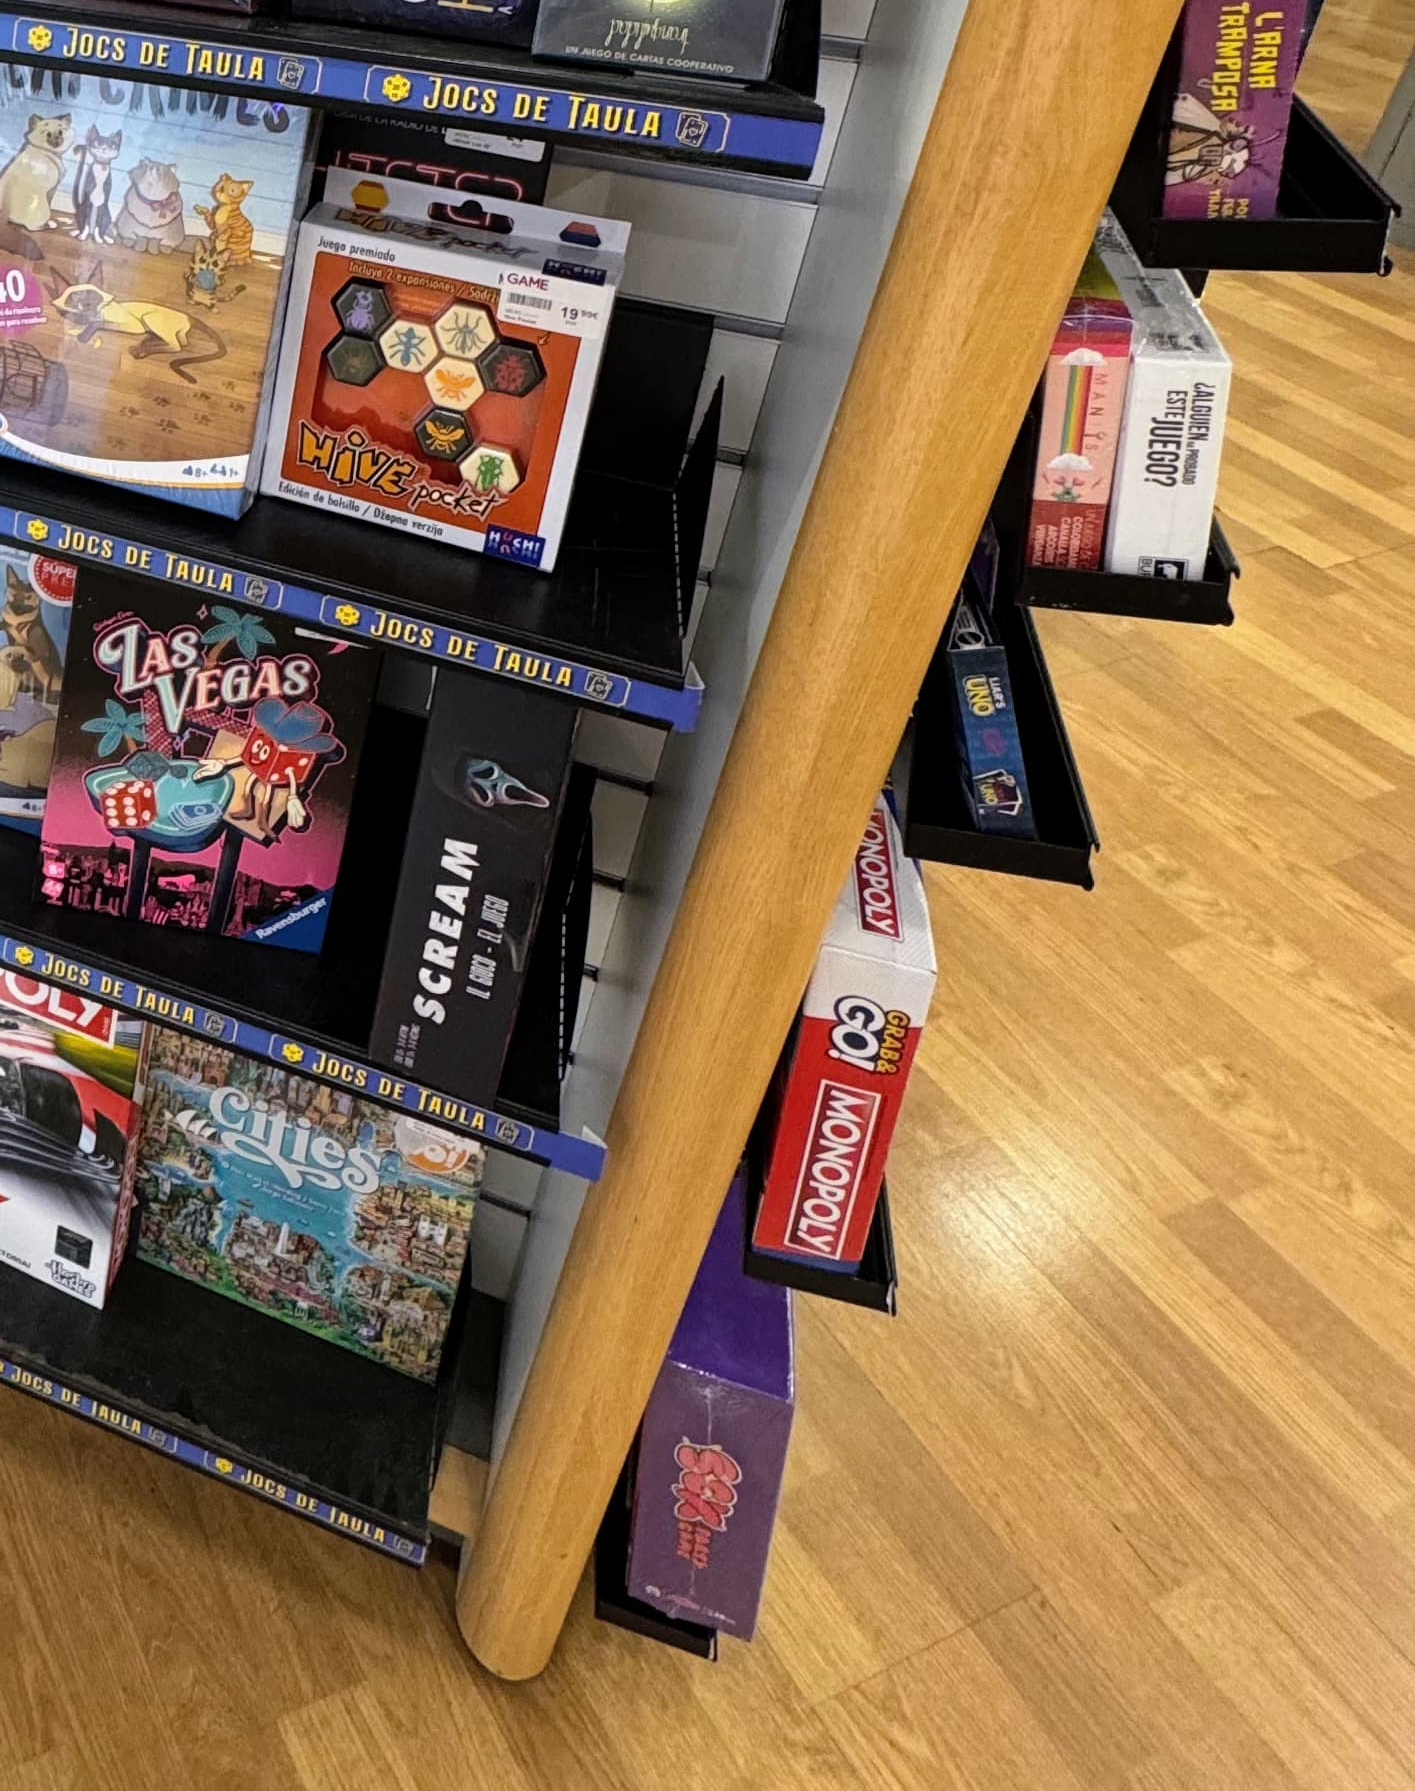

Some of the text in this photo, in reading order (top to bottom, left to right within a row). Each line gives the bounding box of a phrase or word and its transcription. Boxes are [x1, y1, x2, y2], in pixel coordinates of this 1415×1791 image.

[581, 48, 612, 58] JUEGO
[614, 51, 626, 60] DE
[630, 53, 664, 65] CARTAS
[667, 57, 734, 74] COOPERATIVO
[1211, 0, 1251, 113] TRAMPOSA
[317, 237, 396, 263] Juego premiado
[349, 261, 455, 294] Incluye 2 expansiones
[1144, 390, 1188, 488] ESTE JUEGO?
[1188, 382, 1216, 441] ¿ALGUIEN
[278, 482, 309, 502] Edición
[312, 491, 324, 504] de
[328, 492, 361, 514] bolsillo
[411, 480, 504, 517] pocket
[94, 621, 205, 696] LAS
[155, 660, 312, 735] VEGAS
[964, 674, 994, 719] UNO
[254, 895, 328, 941] Ravensburger
[412, 837, 480, 1026] SCREAM
[827, 996, 887, 1074] GO!
[312, 1052, 486, 1130] JOCS DE TAULA
[796, 1089, 867, 1254] MONOPOLY
[239, 1466, 386, 1544] JOCS DE TAULA
